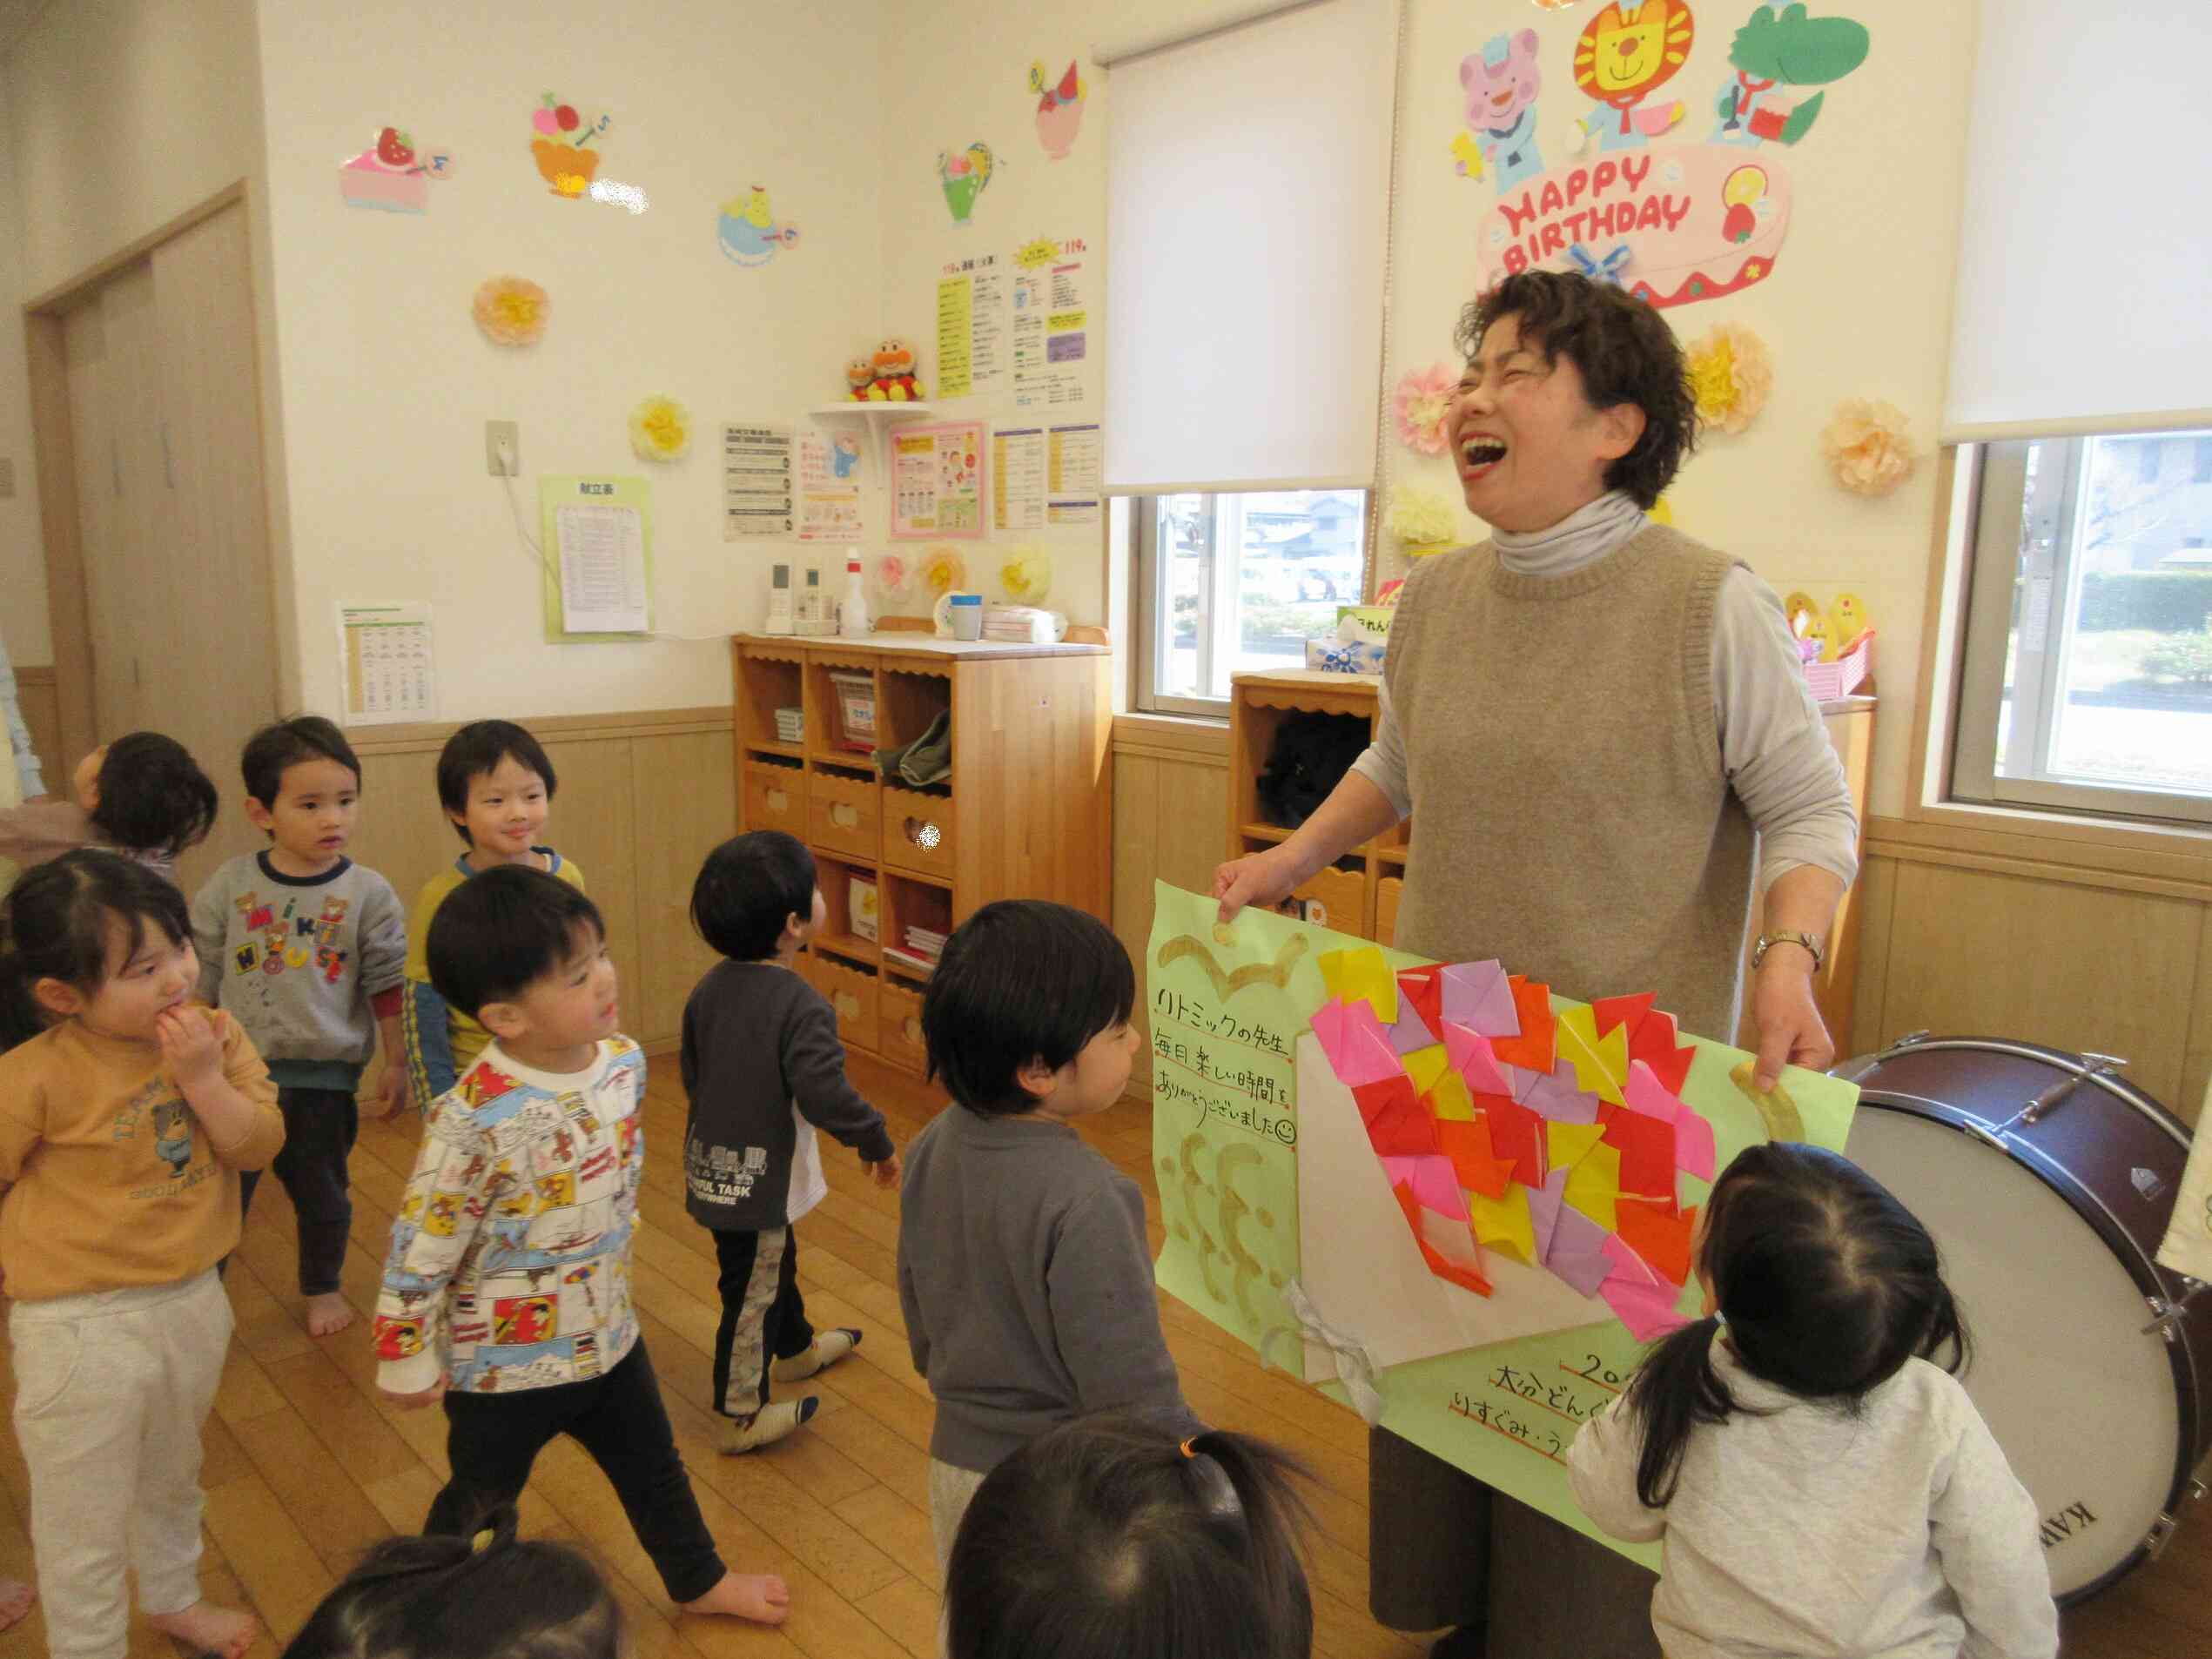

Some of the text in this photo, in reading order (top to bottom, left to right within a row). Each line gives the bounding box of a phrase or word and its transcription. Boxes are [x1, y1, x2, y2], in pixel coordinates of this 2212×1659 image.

[1497, 155, 1651, 238] HAPPY
[1503, 194, 1691, 275] BIRTHDAY
[1157, 988, 1289, 1056] リトミックの先生
[717, 1183, 751, 1199] TASK
